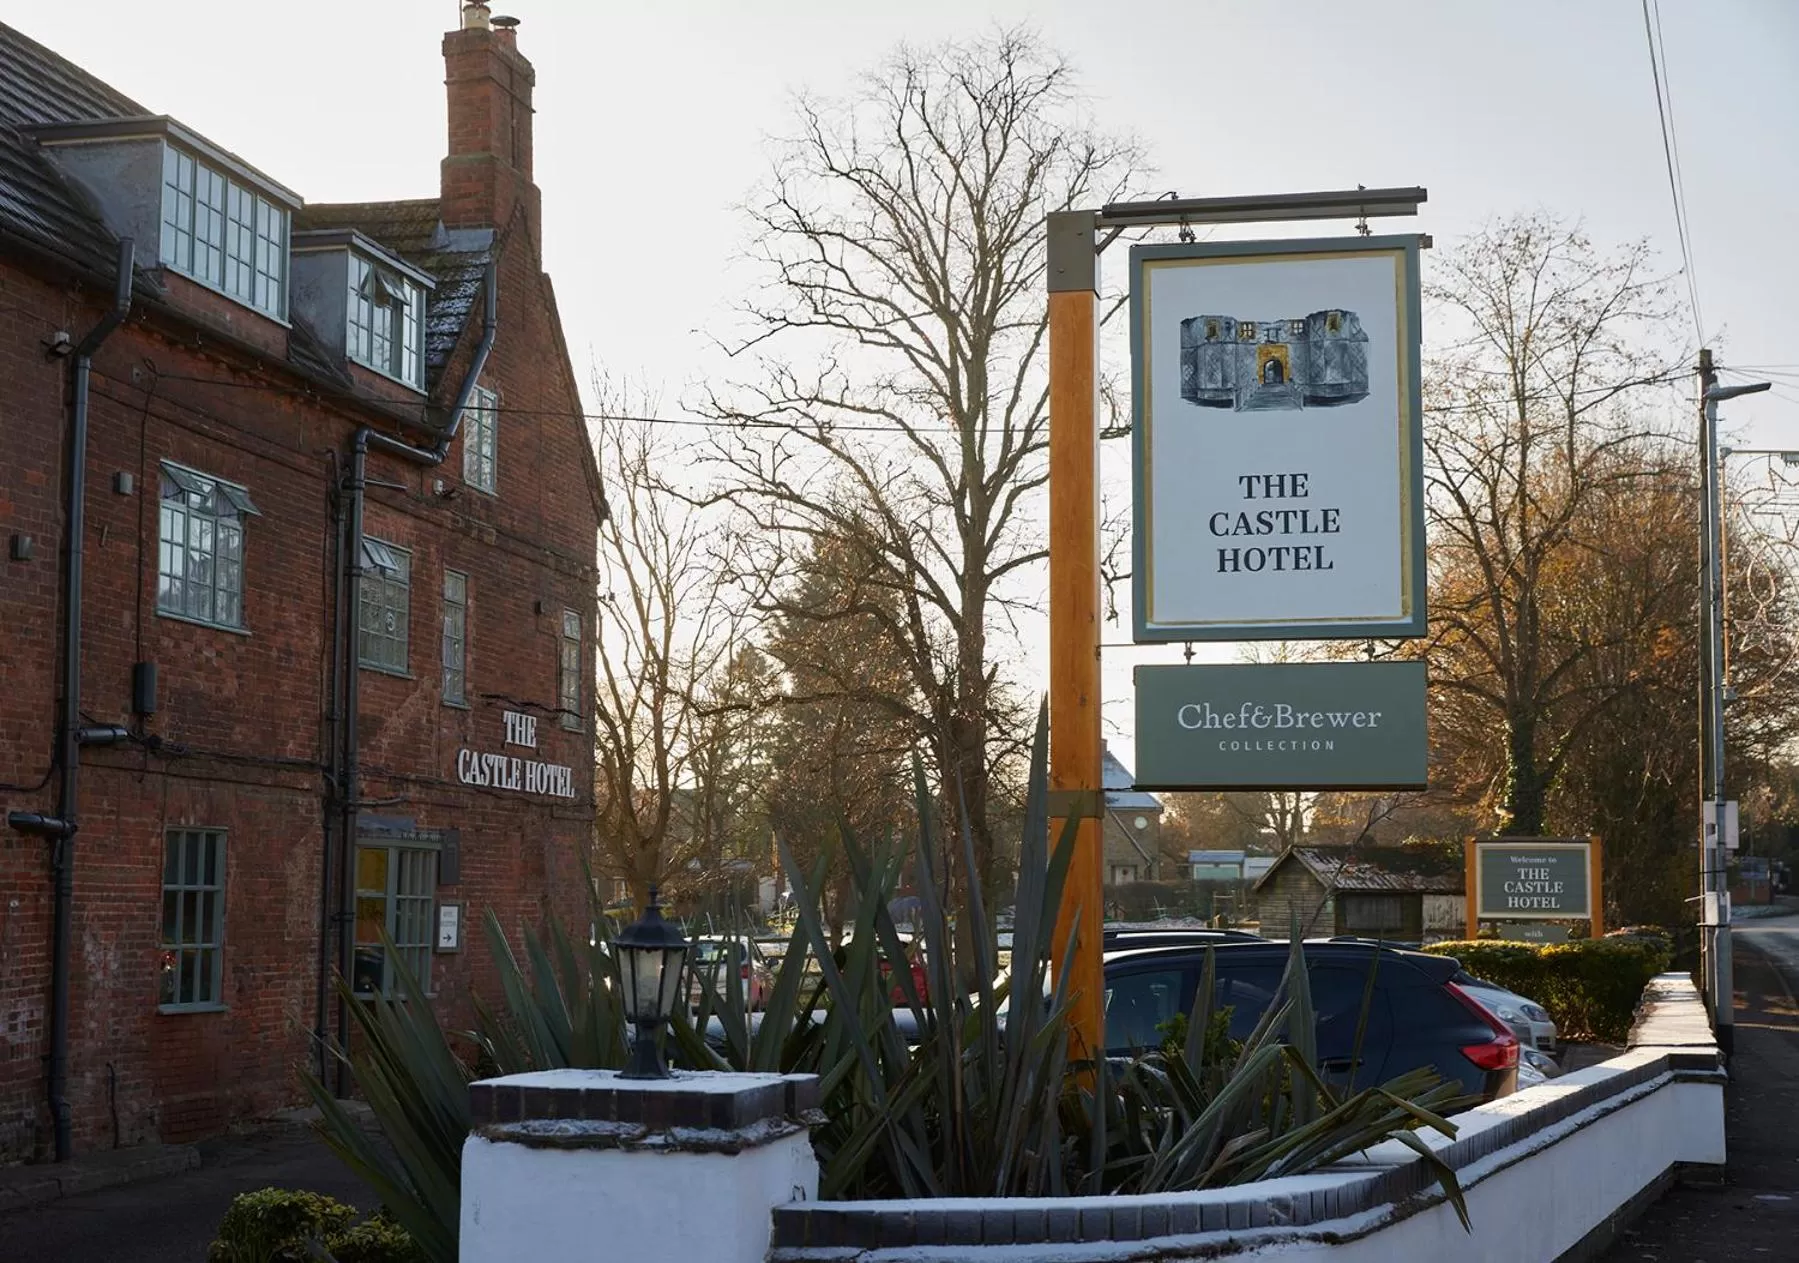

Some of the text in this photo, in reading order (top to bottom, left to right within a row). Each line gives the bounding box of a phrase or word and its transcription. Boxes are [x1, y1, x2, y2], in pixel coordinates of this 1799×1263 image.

[1239, 473, 1309, 499] THE
[1209, 508, 1340, 536] CASTLE
[1217, 545, 1334, 573] HOTEL
[1177, 702, 1382, 729] Chef&Brewer
[503, 710, 537, 748] THE
[1219, 740, 1335, 751] COLLECTION
[458, 749, 575, 798] CASTLE HOTEL
[1510, 856, 1557, 864] Welcome to
[1517, 867, 1550, 880] THE
[1504, 881, 1564, 894] CASTLE
[1508, 896, 1560, 909] HOTEL
[1524, 930, 1543, 938] with
